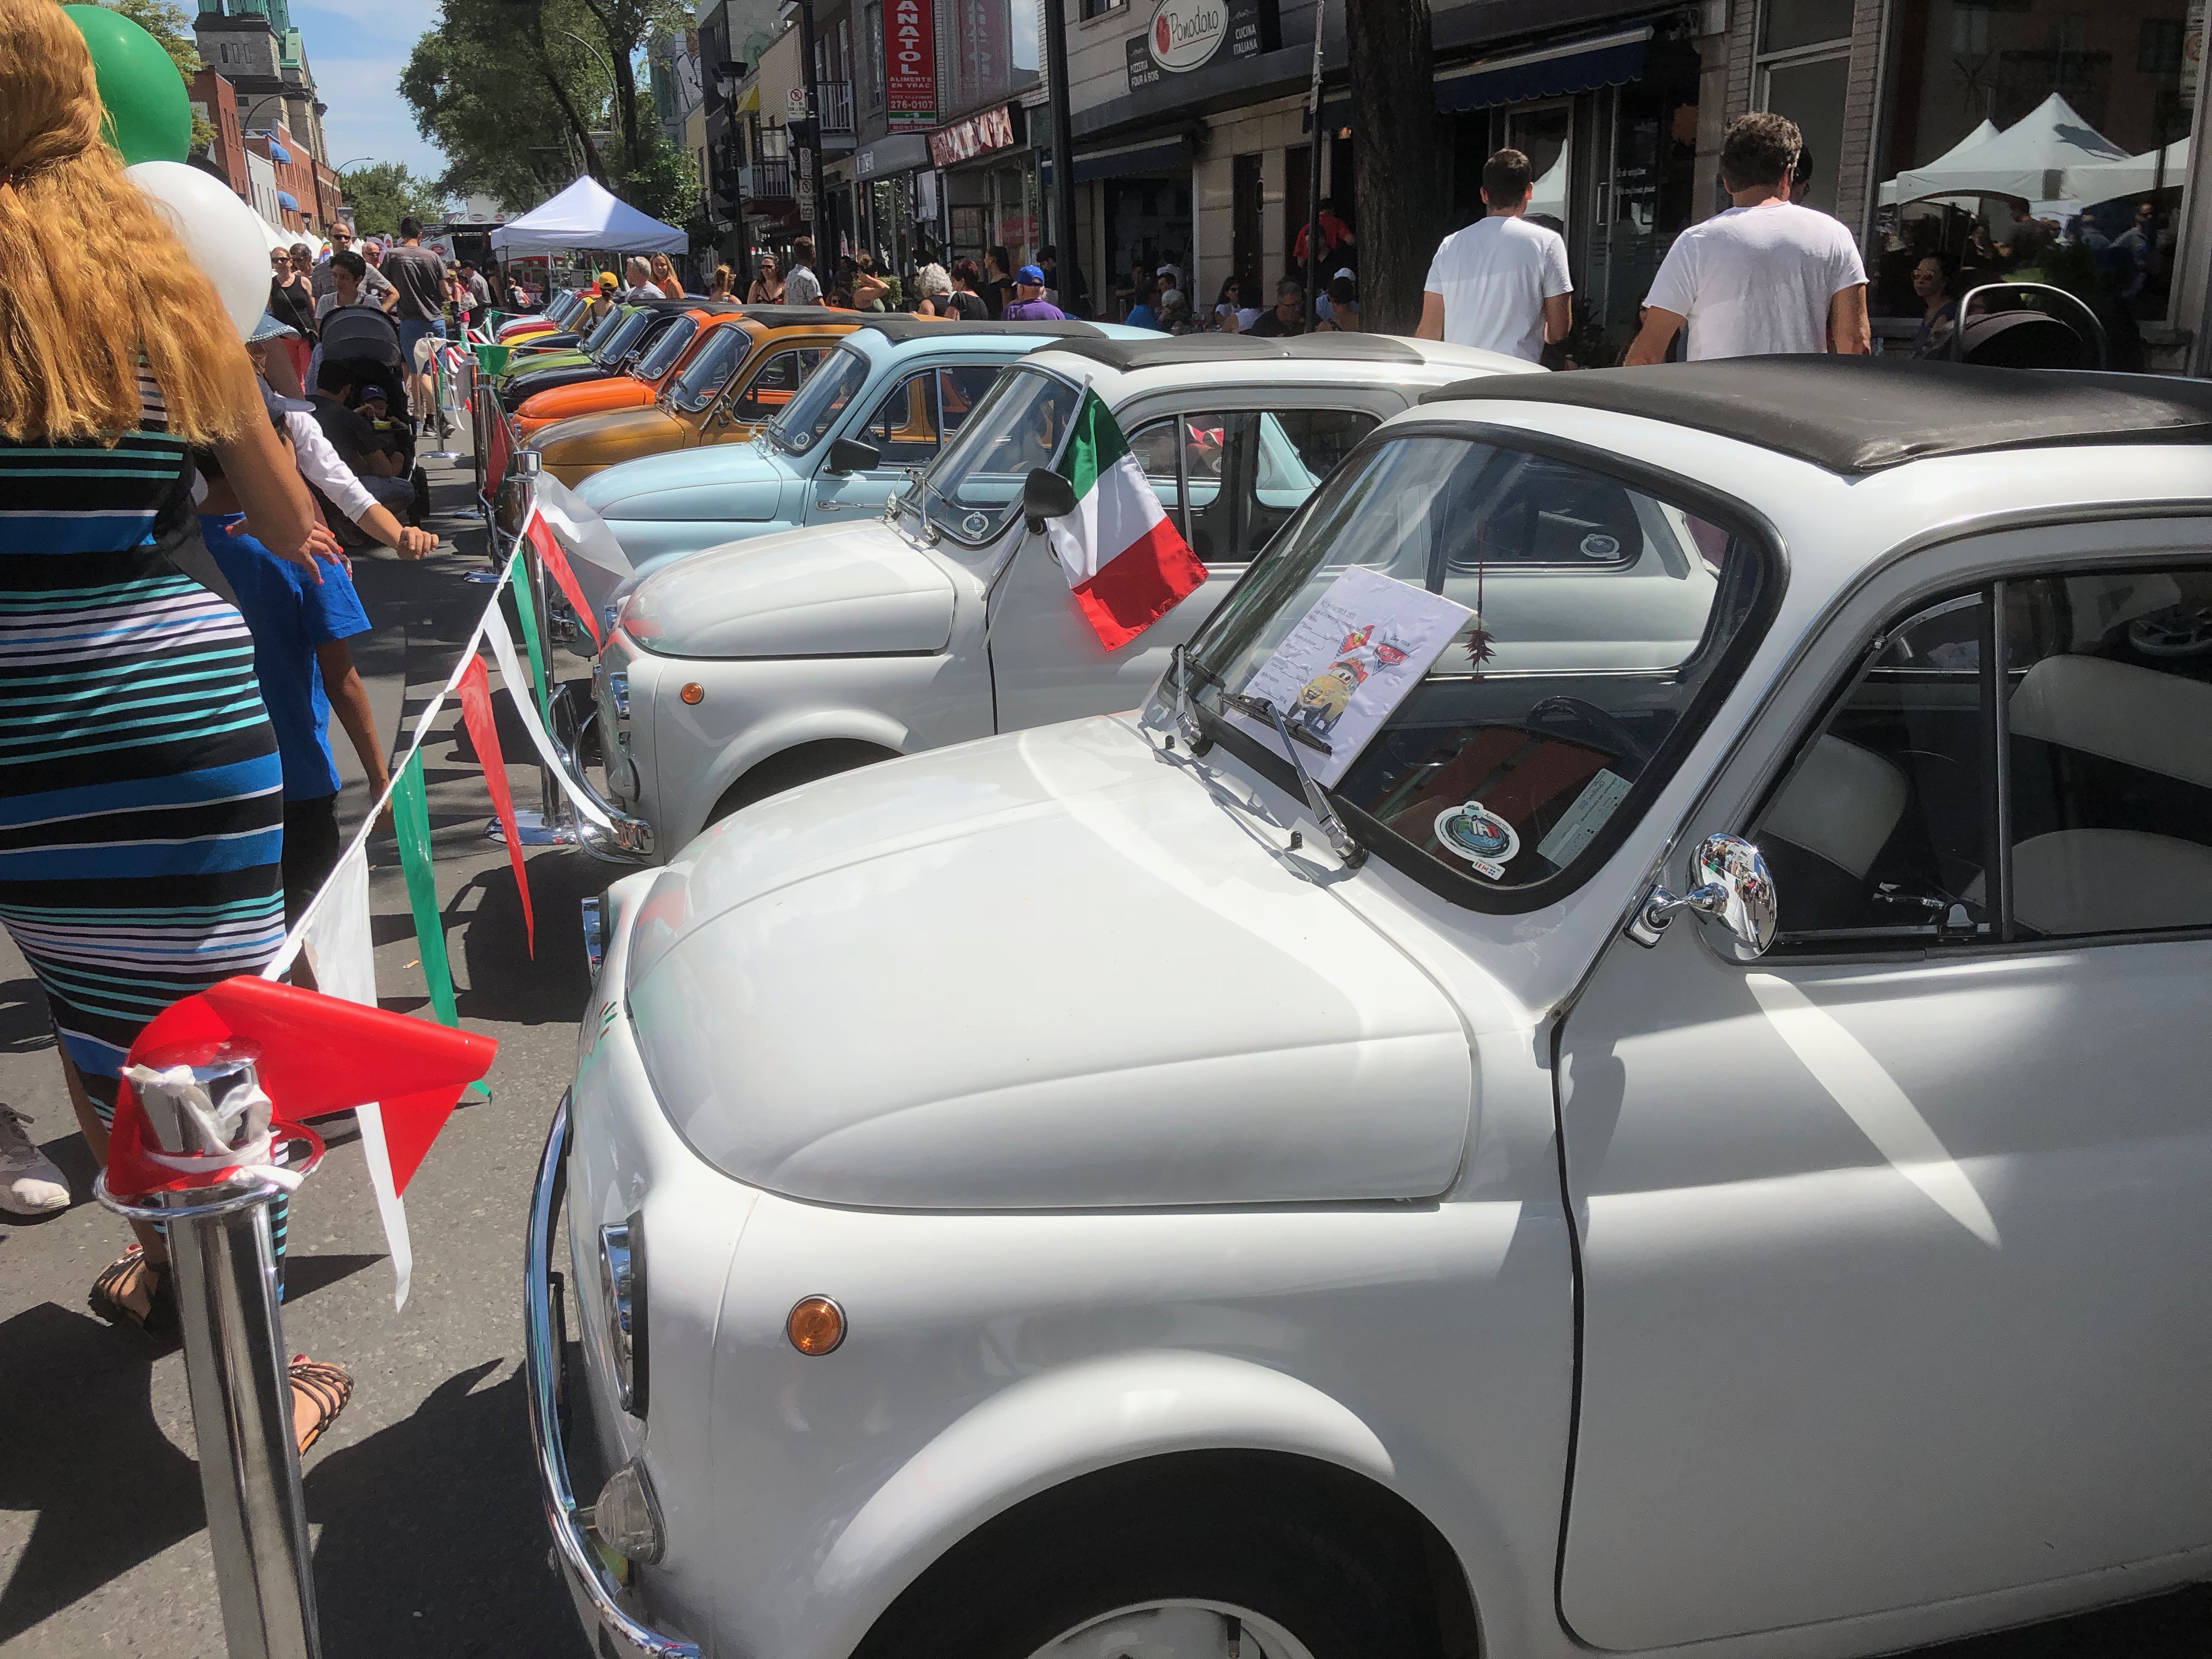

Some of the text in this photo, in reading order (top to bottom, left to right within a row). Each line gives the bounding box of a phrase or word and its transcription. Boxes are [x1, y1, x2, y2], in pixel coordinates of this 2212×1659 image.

[1169, 5, 1218, 43] Pomodoro
[1235, 24, 1256, 40] CUCINA
[896, 1, 921, 75] ANATOL
[1233, 38, 1258, 55] ITALIANA
[1130, 60, 1148, 74] PIZZERIA
[1132, 76, 1143, 87] FOUR
[1147, 70, 1159, 82] BOIS
[890, 100, 933, 109] 276-0107
[1378, 646, 1401, 662] Cars
[1458, 819, 1499, 838] FIAT
[1481, 836, 1497, 847] 500
